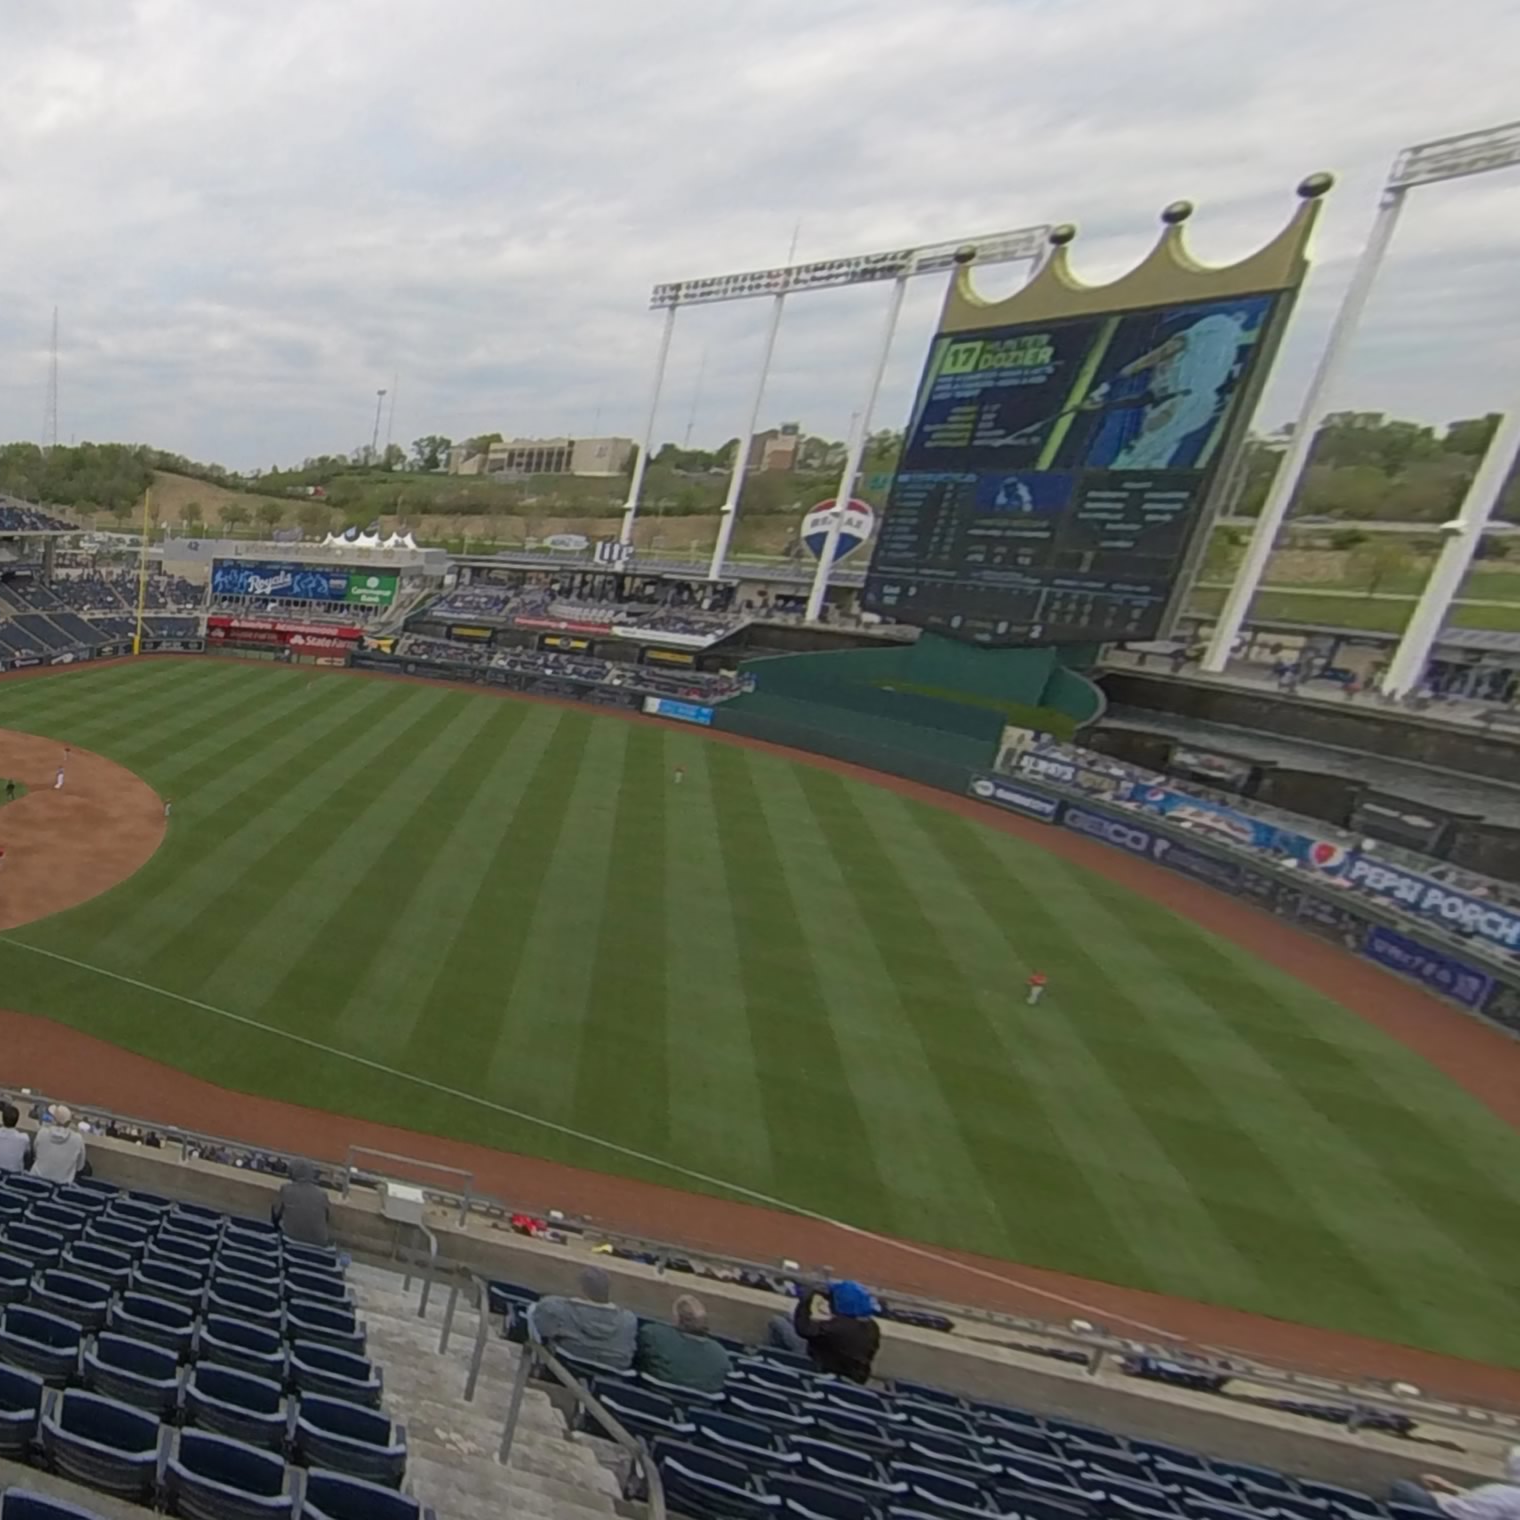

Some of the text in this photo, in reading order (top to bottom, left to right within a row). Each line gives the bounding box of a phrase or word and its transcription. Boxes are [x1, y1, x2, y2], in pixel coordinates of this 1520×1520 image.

[951, 347, 977, 369] 17
[247, 571, 292, 595] Royals
[305, 635, 331, 647] State
[1064, 808, 1149, 851] GEICO
[1351, 861, 1520, 944] PEPSI PORCH
